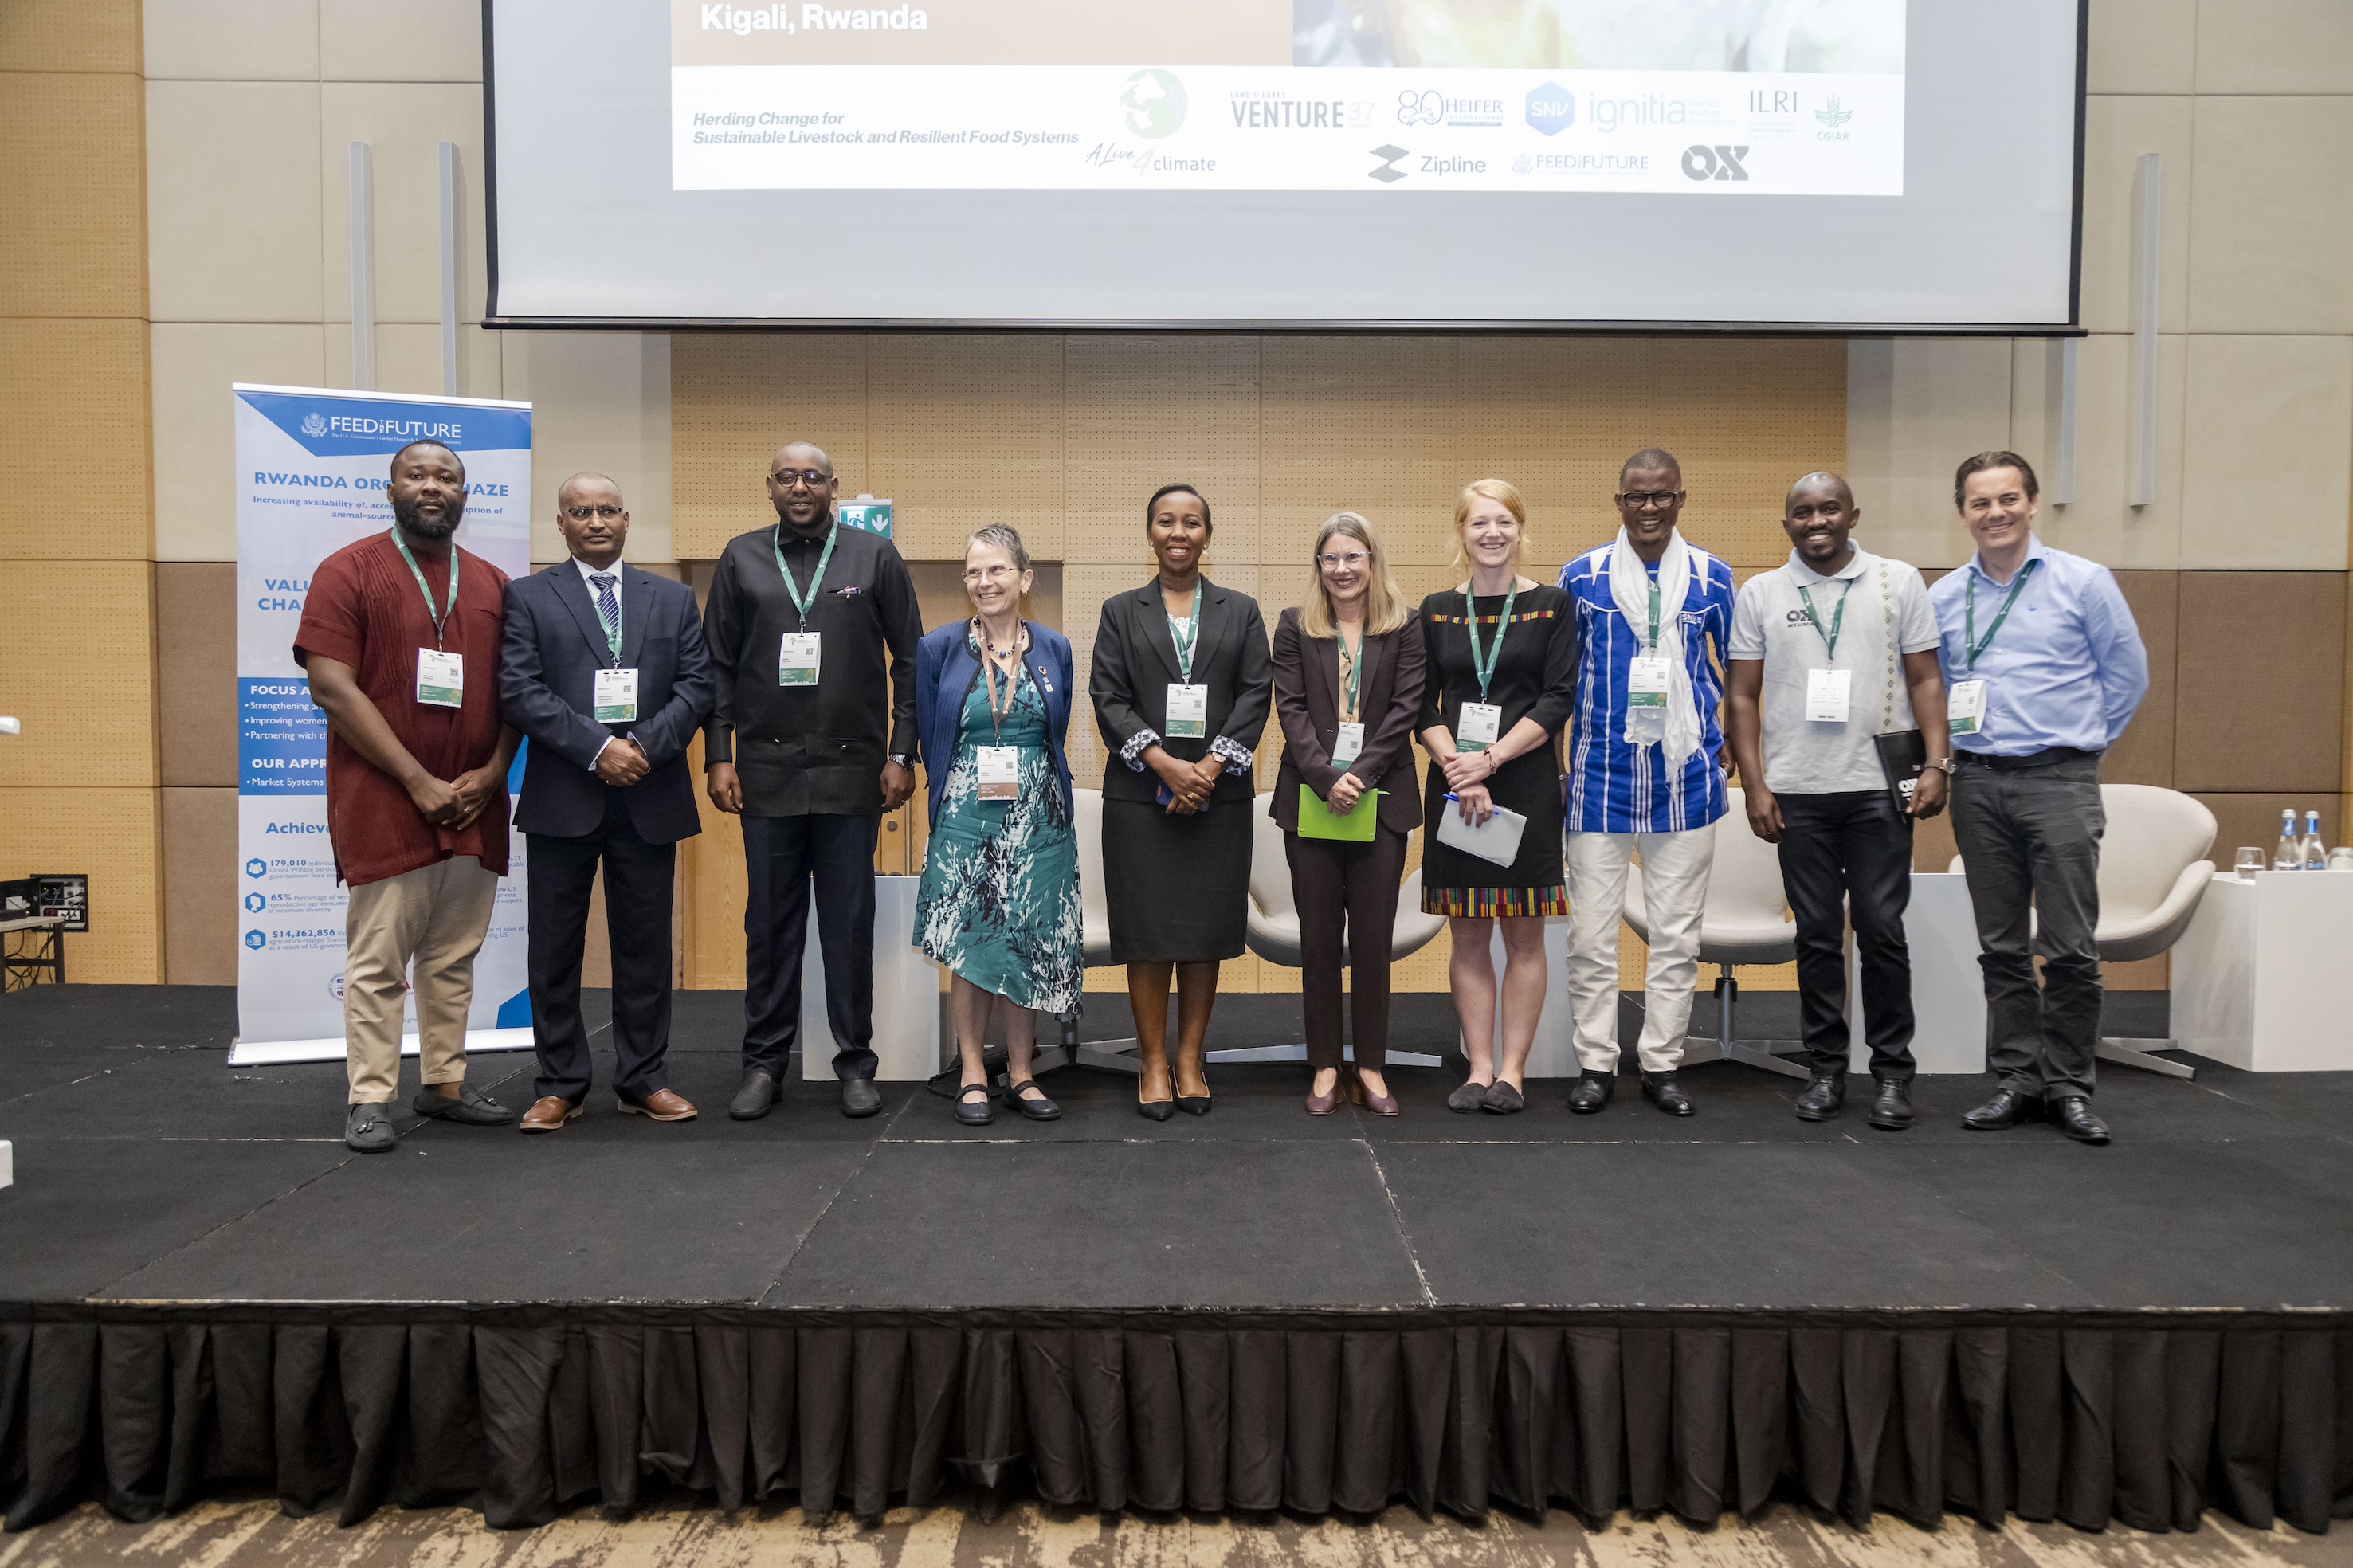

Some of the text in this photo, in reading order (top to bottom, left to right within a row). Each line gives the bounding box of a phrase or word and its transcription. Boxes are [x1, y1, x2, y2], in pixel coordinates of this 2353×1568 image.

[700, 4, 928, 36] Kigali, Rwanda
[1445, 98, 1504, 113] HEIFER
[1531, 100, 1570, 118] SNV
[1749, 90, 1798, 113] ILRI
[693, 112, 845, 127] Herding Change for
[1231, 101, 1377, 128] VENTURE 37
[1589, 92, 1687, 134] ignitia
[693, 130, 1079, 145] Sustainable Livestock and Resilient Food Systems
[1817, 132, 1849, 141] CGIAR
[1153, 156, 1217, 171] climate
[1420, 155, 1486, 176] Zipline
[1536, 155, 1577, 168] FEED
[1582, 155, 1649, 169] FUTURE
[1681, 144, 1750, 182] OX
[331, 416, 378, 433] FEED
[385, 420, 461, 438] FUTURE
[254, 472, 348, 489] RWANDA
[463, 483, 508, 496] HAZE
[253, 496, 300, 507] Increasing
[303, 499, 353, 509] availability
[257, 598, 303, 611] CHA
[250, 685, 297, 695] FOCUS
[250, 701, 309, 711] Strengthening
[251, 716, 293, 727] Improving
[251, 731, 295, 741] Partnering
[252, 759, 327, 769] OUR APPR
[252, 778, 324, 788] Market Systems
[273, 929, 335, 938] $14,362,856
